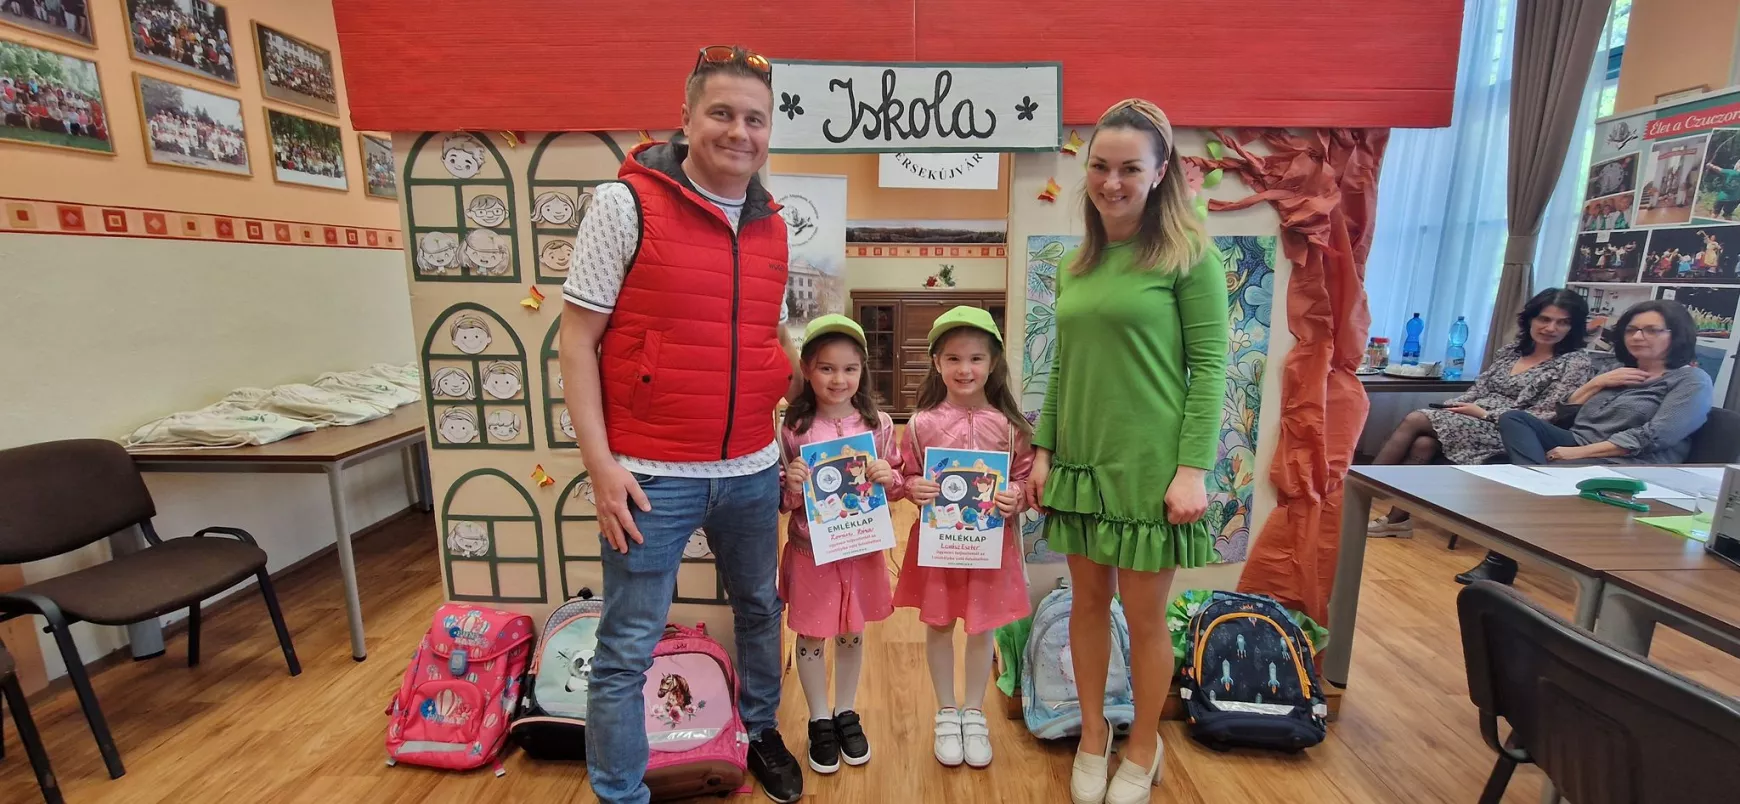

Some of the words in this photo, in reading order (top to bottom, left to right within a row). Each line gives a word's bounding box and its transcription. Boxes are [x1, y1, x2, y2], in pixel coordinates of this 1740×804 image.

[822, 69, 996, 143] Iskola
[1672, 121, 1682, 131] a
[1685, 110, 1740, 129] Czuczor
[827, 517, 874, 533] EMLÉKLAP
[939, 533, 986, 542] EMLÉKLAP
